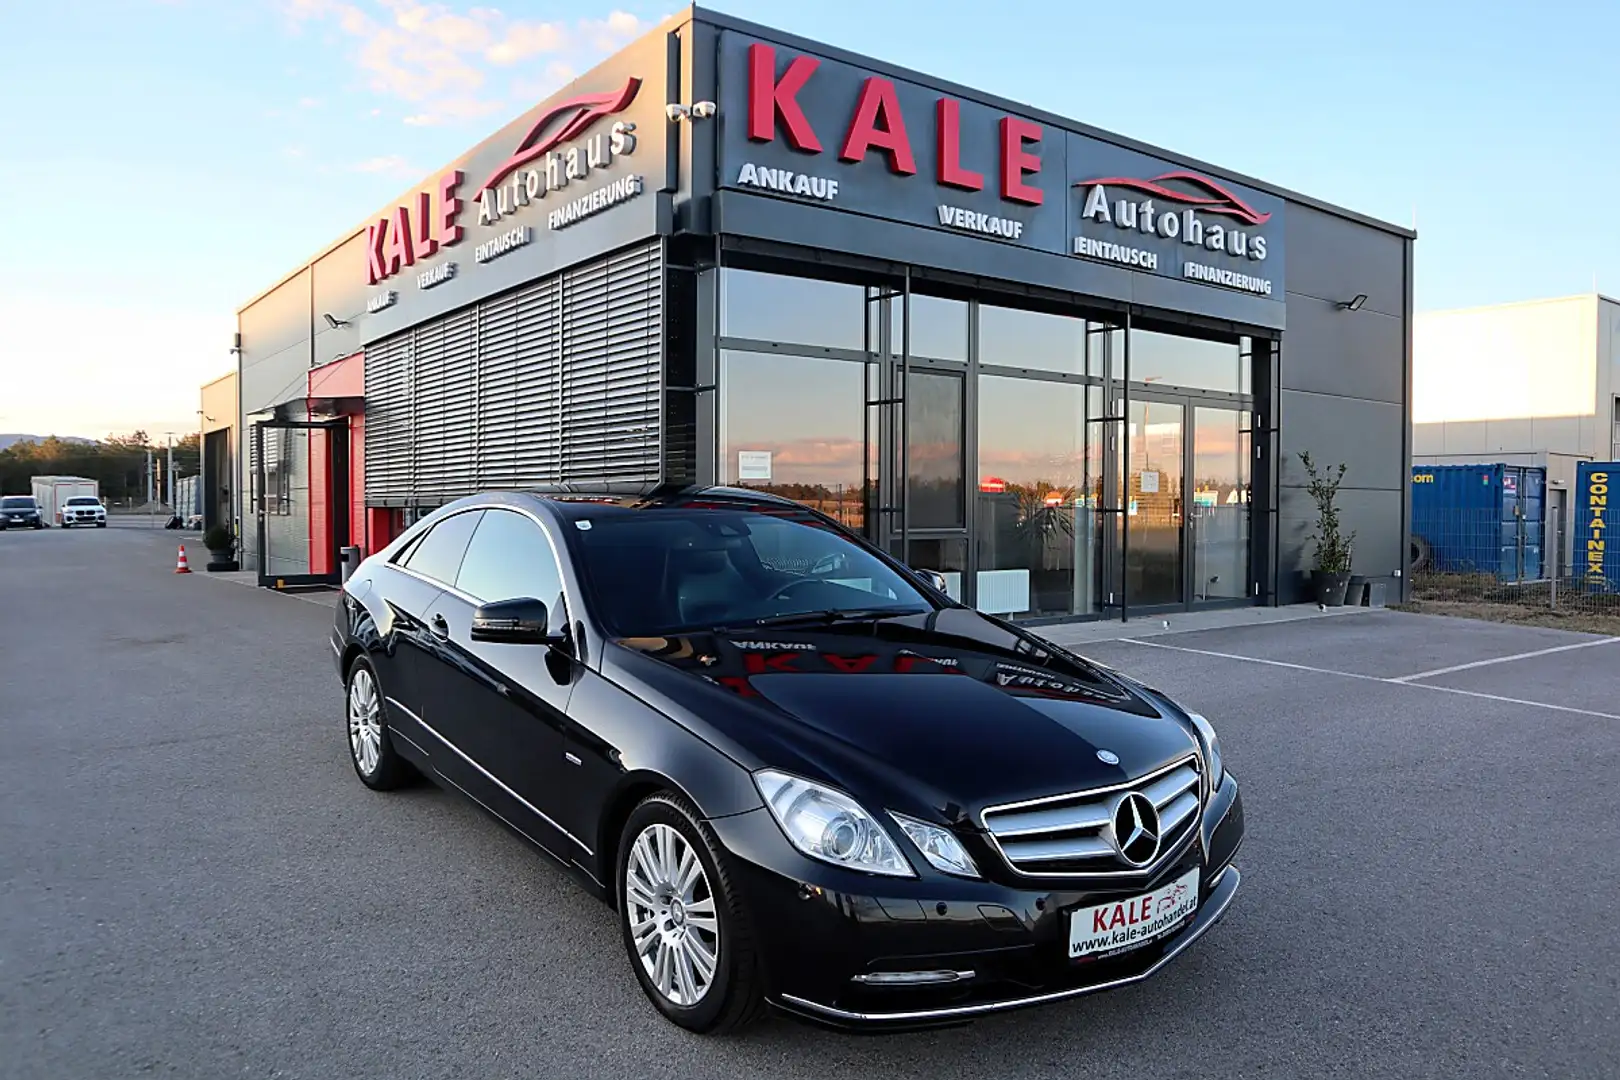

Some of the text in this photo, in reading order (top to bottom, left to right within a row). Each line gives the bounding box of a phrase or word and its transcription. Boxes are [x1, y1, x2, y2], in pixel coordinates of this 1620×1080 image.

[477, 121, 637, 226] Autohaus
[748, 43, 1045, 205] KALE
[365, 170, 465, 285] KALE
[475, 226, 530, 263] EINTAUSCH
[548, 174, 643, 230] FINANZIERUNG
[738, 163, 1272, 295] ANKAUF VERKAUF EINTAUSCH FINANZIERUNG
[1082, 184, 1268, 261] Autohaus
[1588, 472, 1609, 573] CONTAINEX
[1072, 896, 1197, 953] www.kale-autohandel.at
[1093, 896, 1153, 933] KALE
